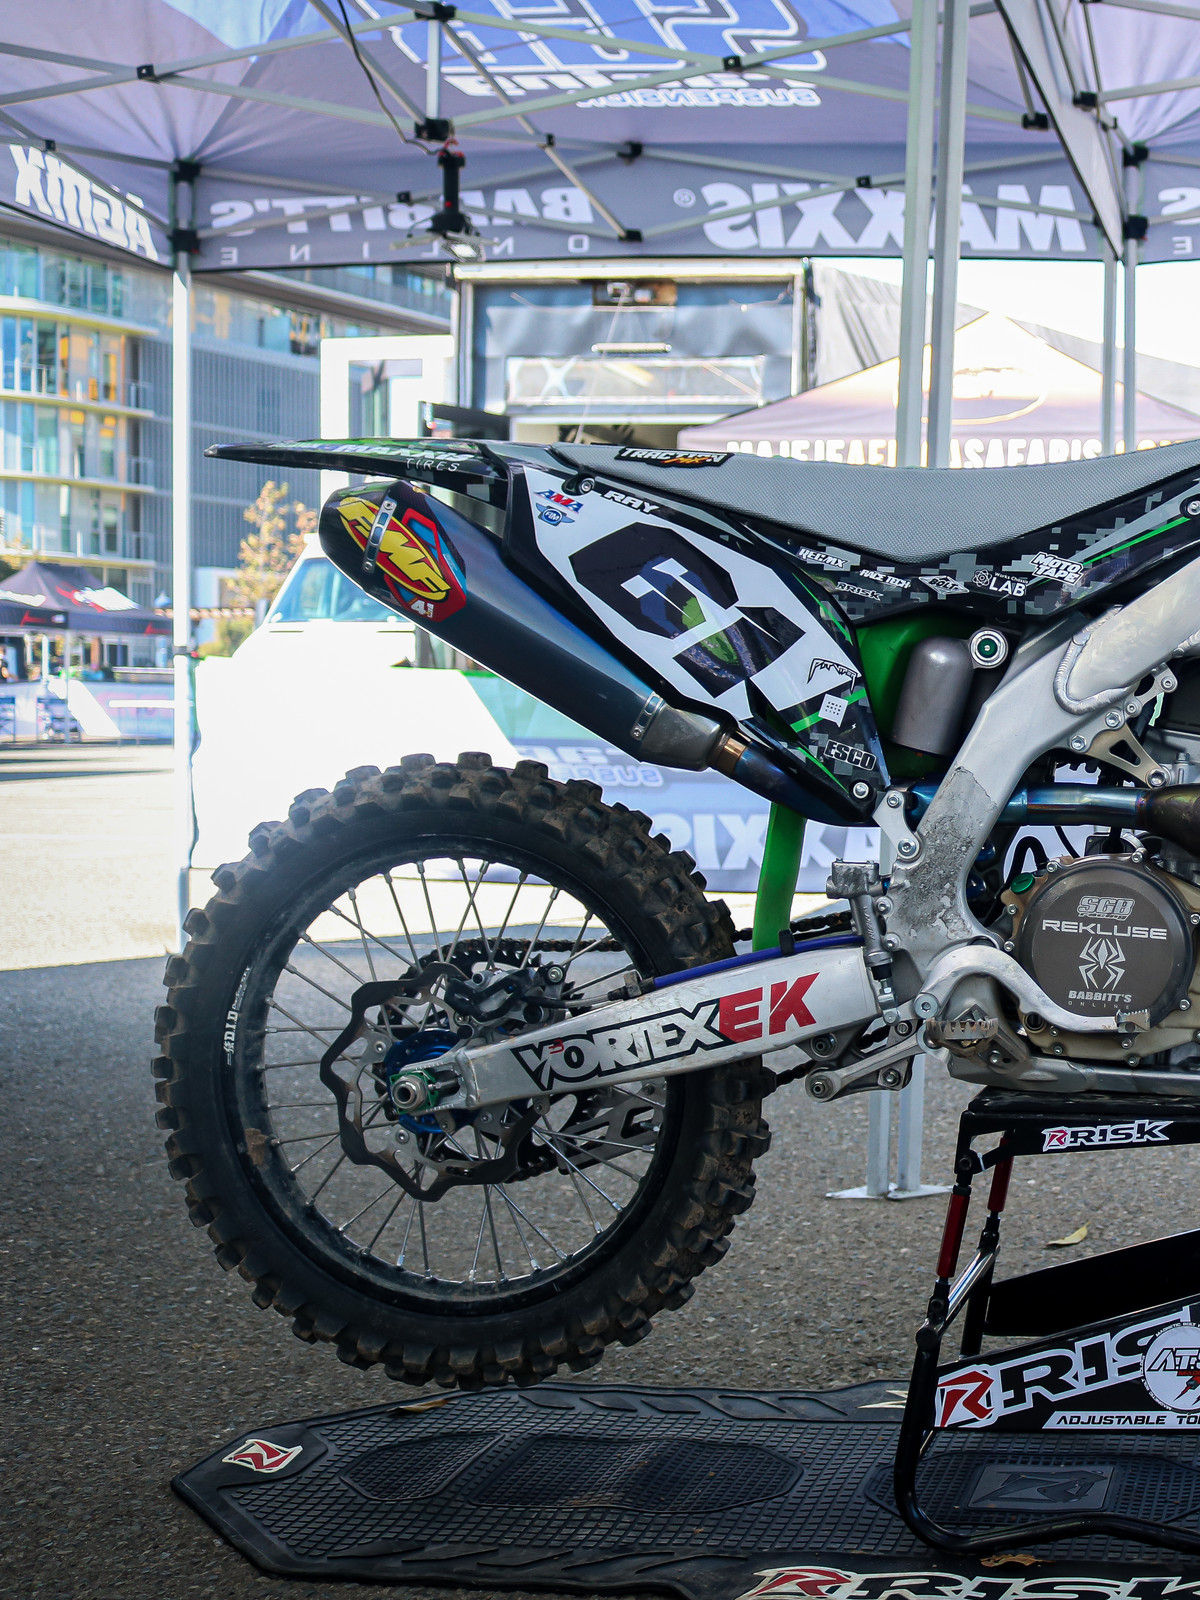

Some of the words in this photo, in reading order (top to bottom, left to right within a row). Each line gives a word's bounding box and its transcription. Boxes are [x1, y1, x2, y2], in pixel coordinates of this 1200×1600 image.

[405, 458, 460, 472] TIRES
[534, 489, 584, 513] AMA
[603, 490, 660, 514] RAY
[545, 510, 561, 521] FIM
[1033, 553, 1082, 573] MOTO
[859, 568, 886, 583] RACE
[885, 574, 912, 589] TECH
[928, 577, 960, 592] BOLT
[1036, 566, 1081, 583] TAPE
[988, 577, 1027, 598] LAB
[1078, 895, 1136, 916] SGB
[1041, 919, 1168, 941] REKLUSE
[1068, 990, 1133, 1003] BABBITT'S
[513, 998, 726, 1090] VORTEX
[719, 972, 820, 1044] EK
[1055, 1413, 1167, 1426] ADJUSTABLE
